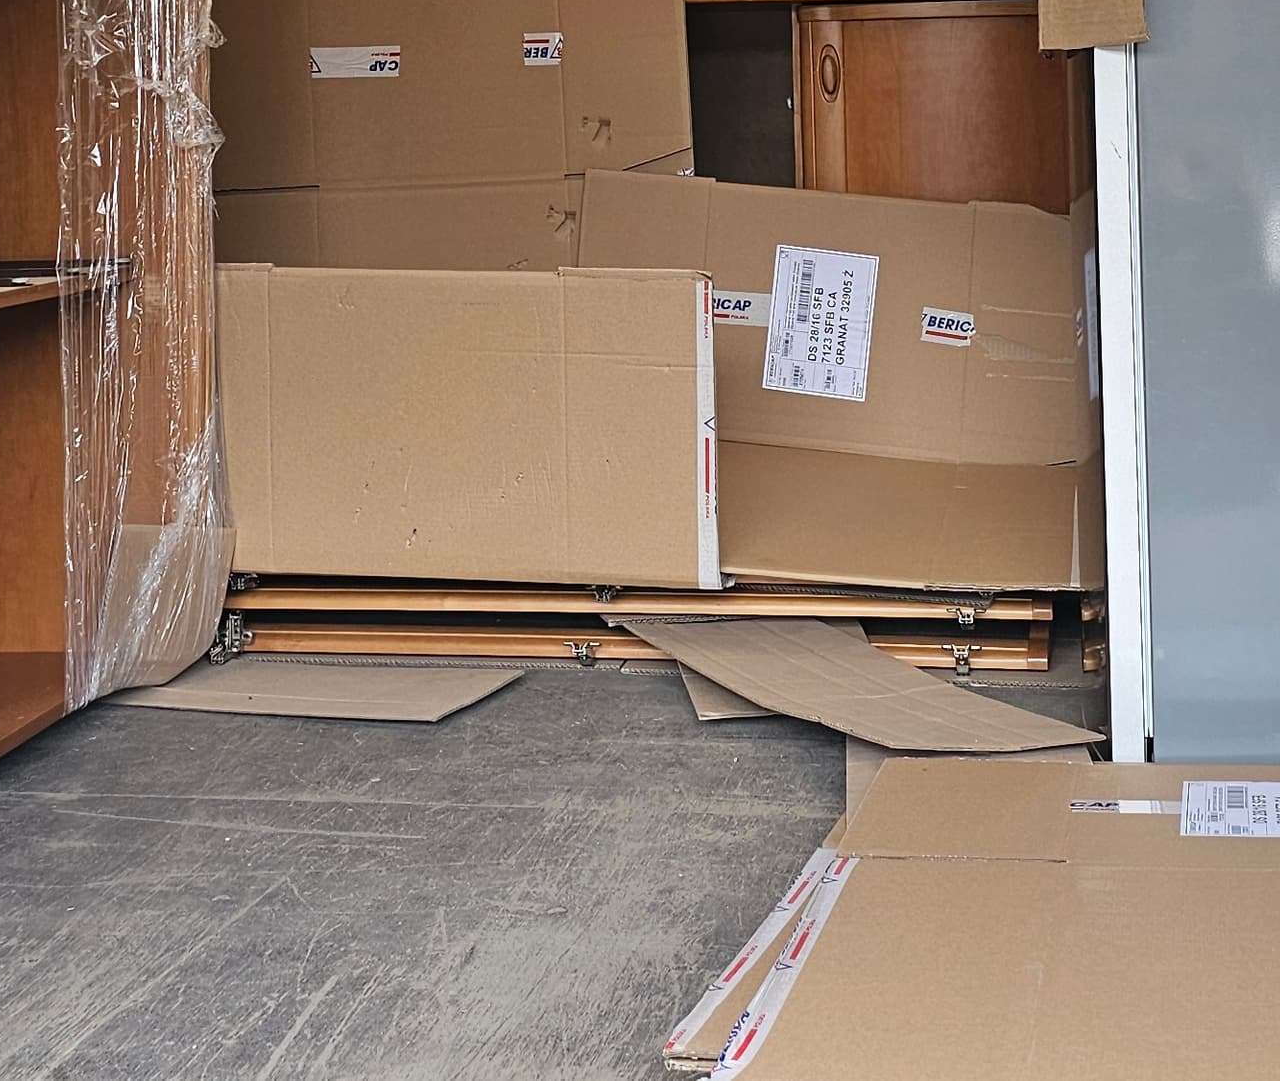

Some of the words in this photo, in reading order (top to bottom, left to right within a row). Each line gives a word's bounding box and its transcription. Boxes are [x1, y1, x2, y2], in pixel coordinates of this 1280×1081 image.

[369, 60, 399, 72] CAP
[813, 287, 824, 311] SFB
[827, 291, 838, 308] CA
[840, 280, 853, 313] 32905
[809, 313, 822, 343] 28/16
[824, 311, 835, 335] SFB
[927, 315, 975, 332] BERIC
[821, 337, 833, 364] 7123
[835, 315, 849, 366] GRANAT
[807, 346, 818, 362] DS
